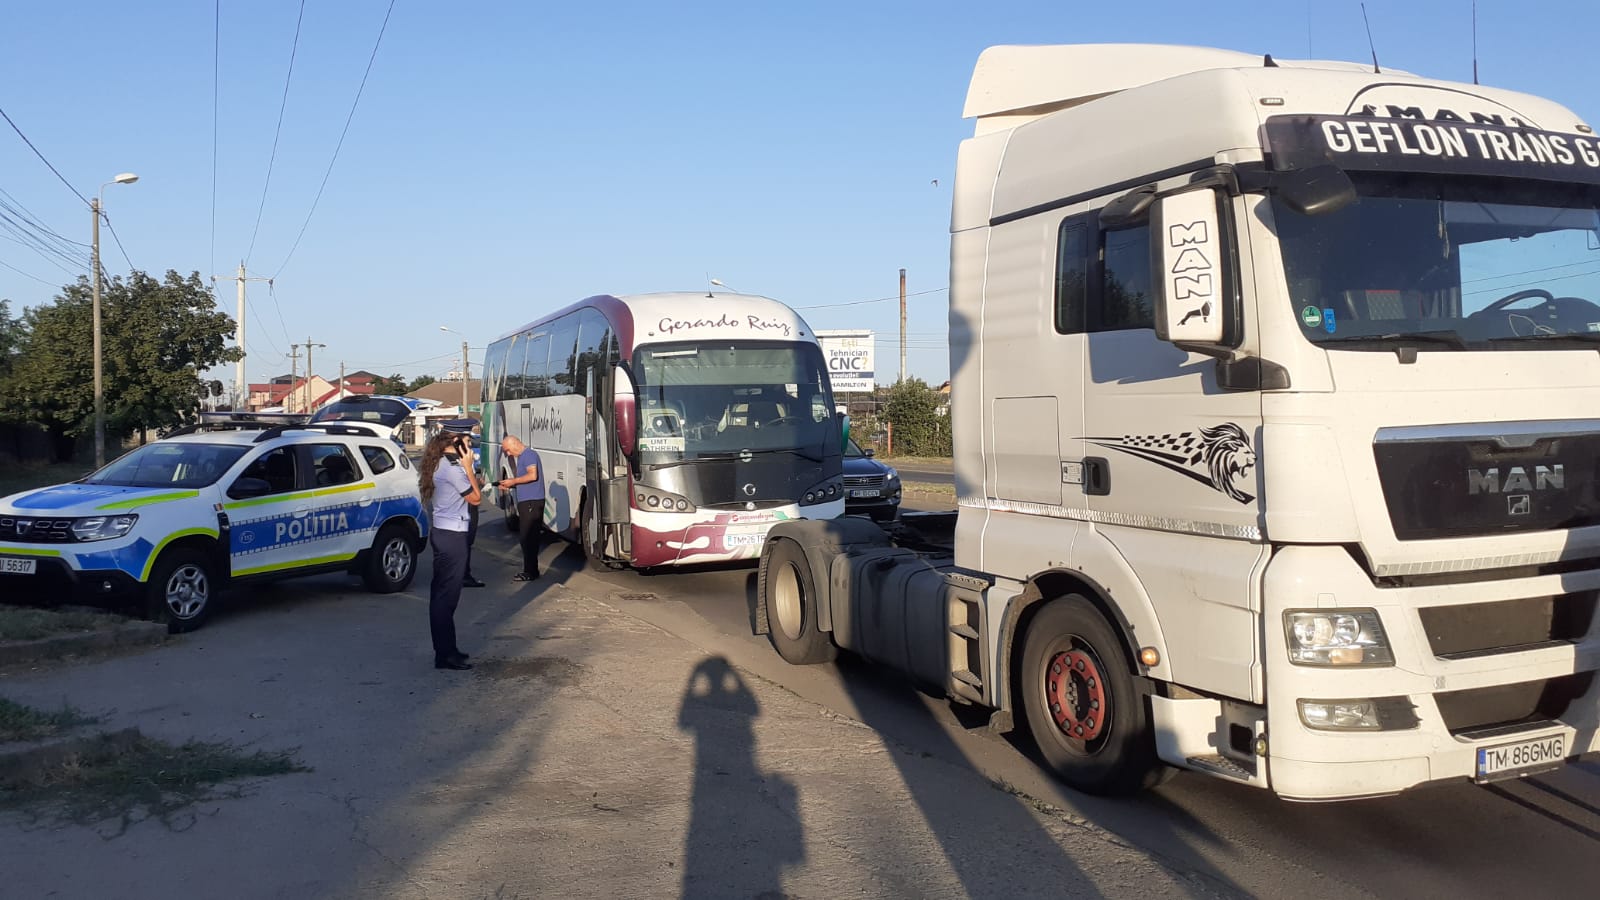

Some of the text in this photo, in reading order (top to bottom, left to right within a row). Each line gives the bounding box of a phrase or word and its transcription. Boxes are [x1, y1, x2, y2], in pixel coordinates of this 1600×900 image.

[1321, 120, 1600, 167] GEFLON TRANS G
[1169, 221, 1212, 300] MAN
[658, 314, 792, 336] Gerardo Ruiz
[1468, 464, 1565, 495] MAN
[1487, 739, 1563, 770] TM 86GMG
